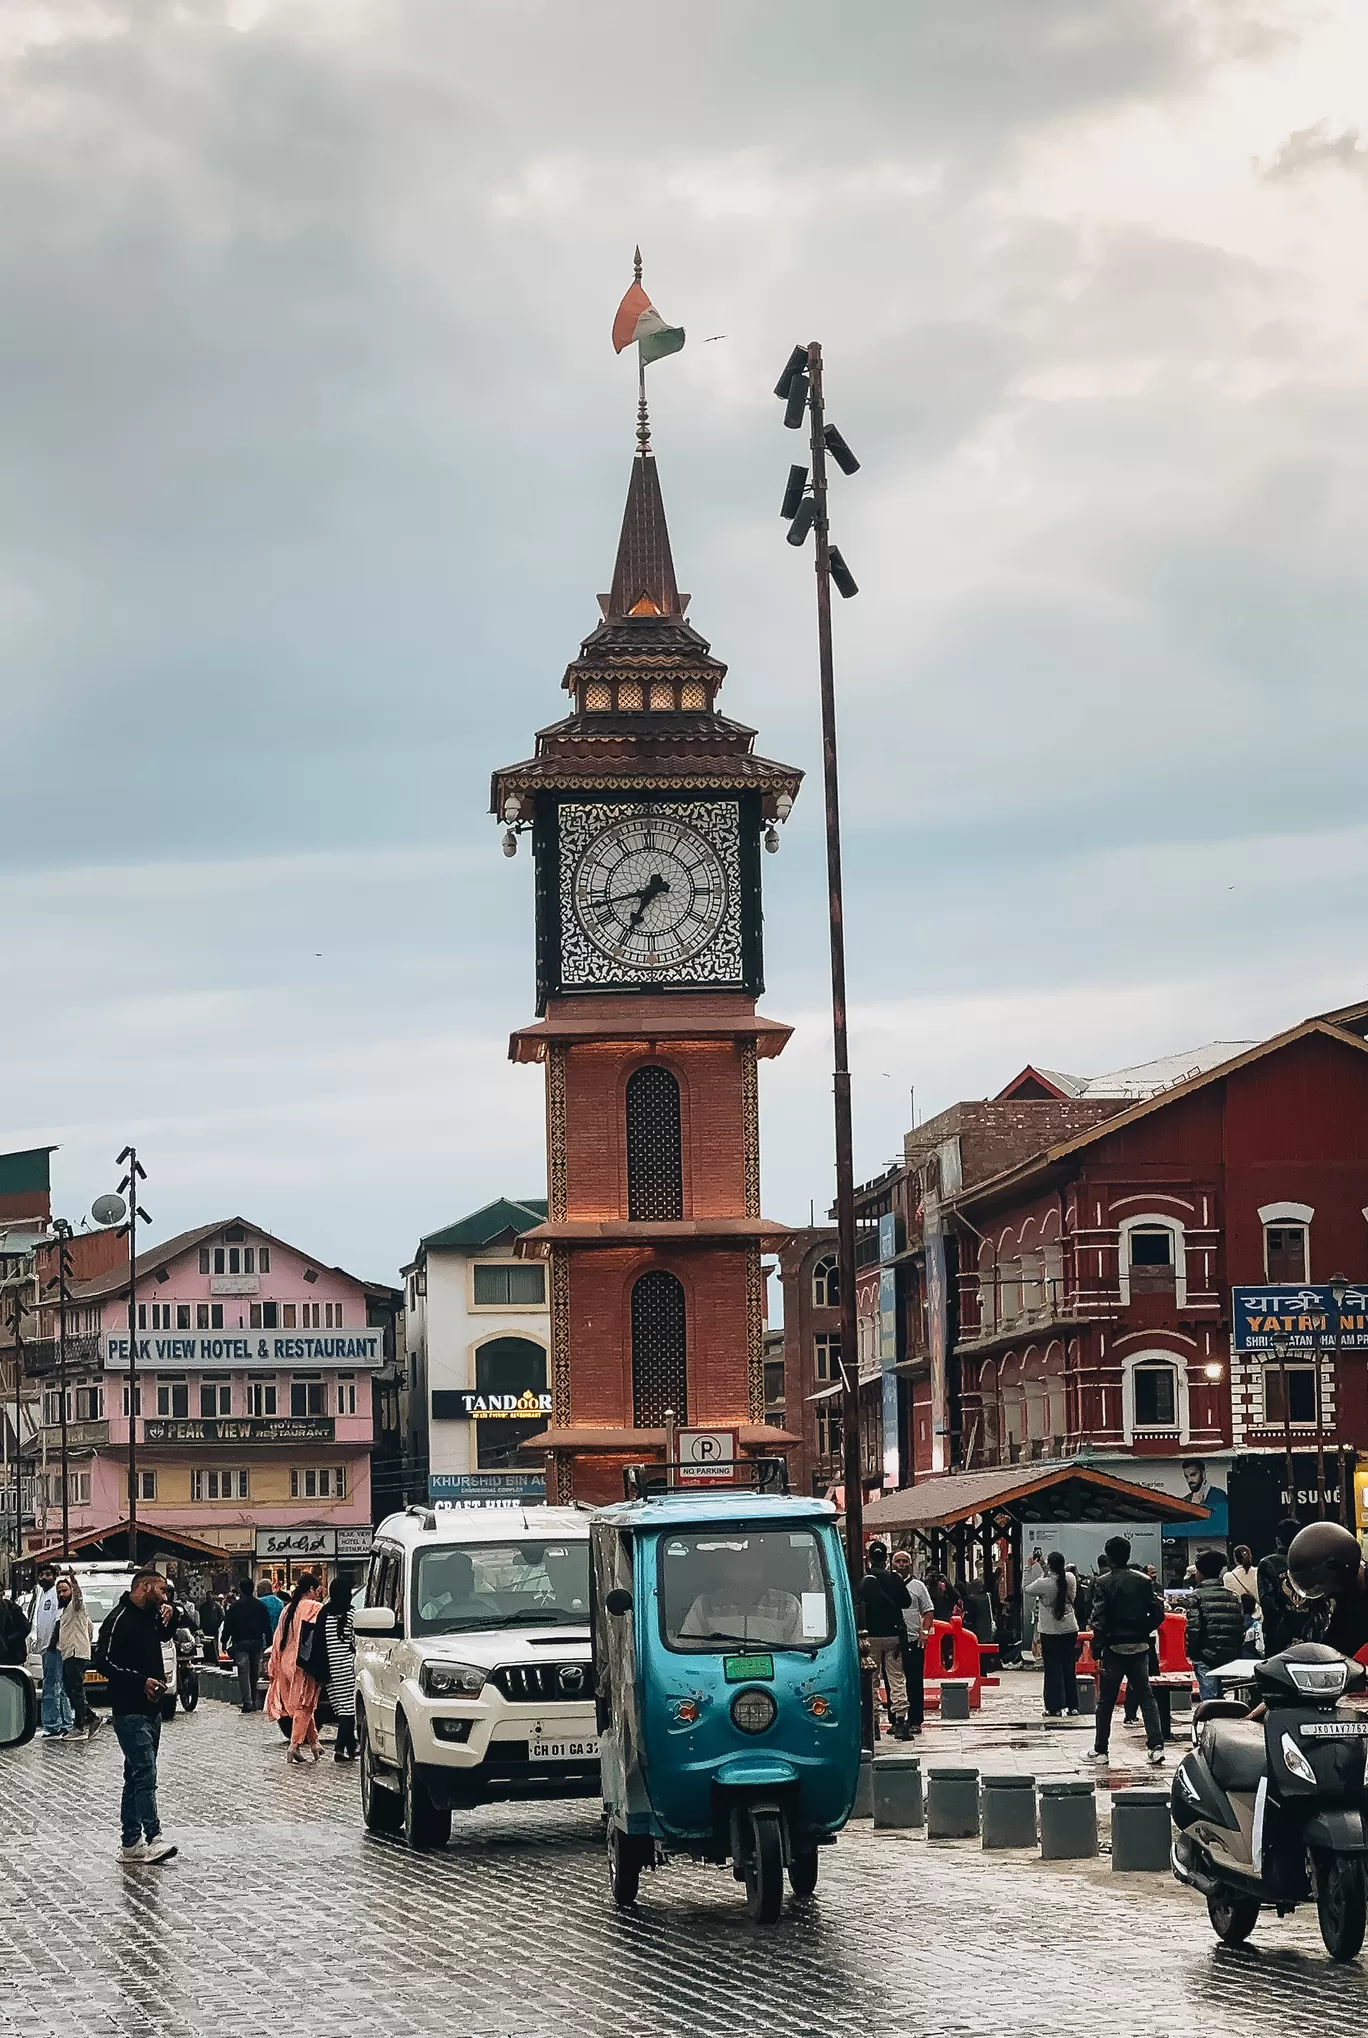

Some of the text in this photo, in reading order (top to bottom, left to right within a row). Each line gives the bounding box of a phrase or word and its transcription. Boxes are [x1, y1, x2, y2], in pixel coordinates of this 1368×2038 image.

[1245, 1316, 1327, 1332] YATRI
[1246, 1336, 1268, 1347] SHRI
[155, 1339, 196, 1360] VIEW
[200, 1339, 252, 1359] HOTEL
[257, 1339, 269, 1359] &
[274, 1338, 377, 1359] RESTAURANT
[168, 1424, 204, 1439] PEAK
[216, 1422, 251, 1438] VIEW
[683, 1466, 731, 1475] NO PARKING
[432, 1476, 501, 1487] KHURSHID
[534, 1744, 548, 1756] CH
[552, 1744, 565, 1755] 01
